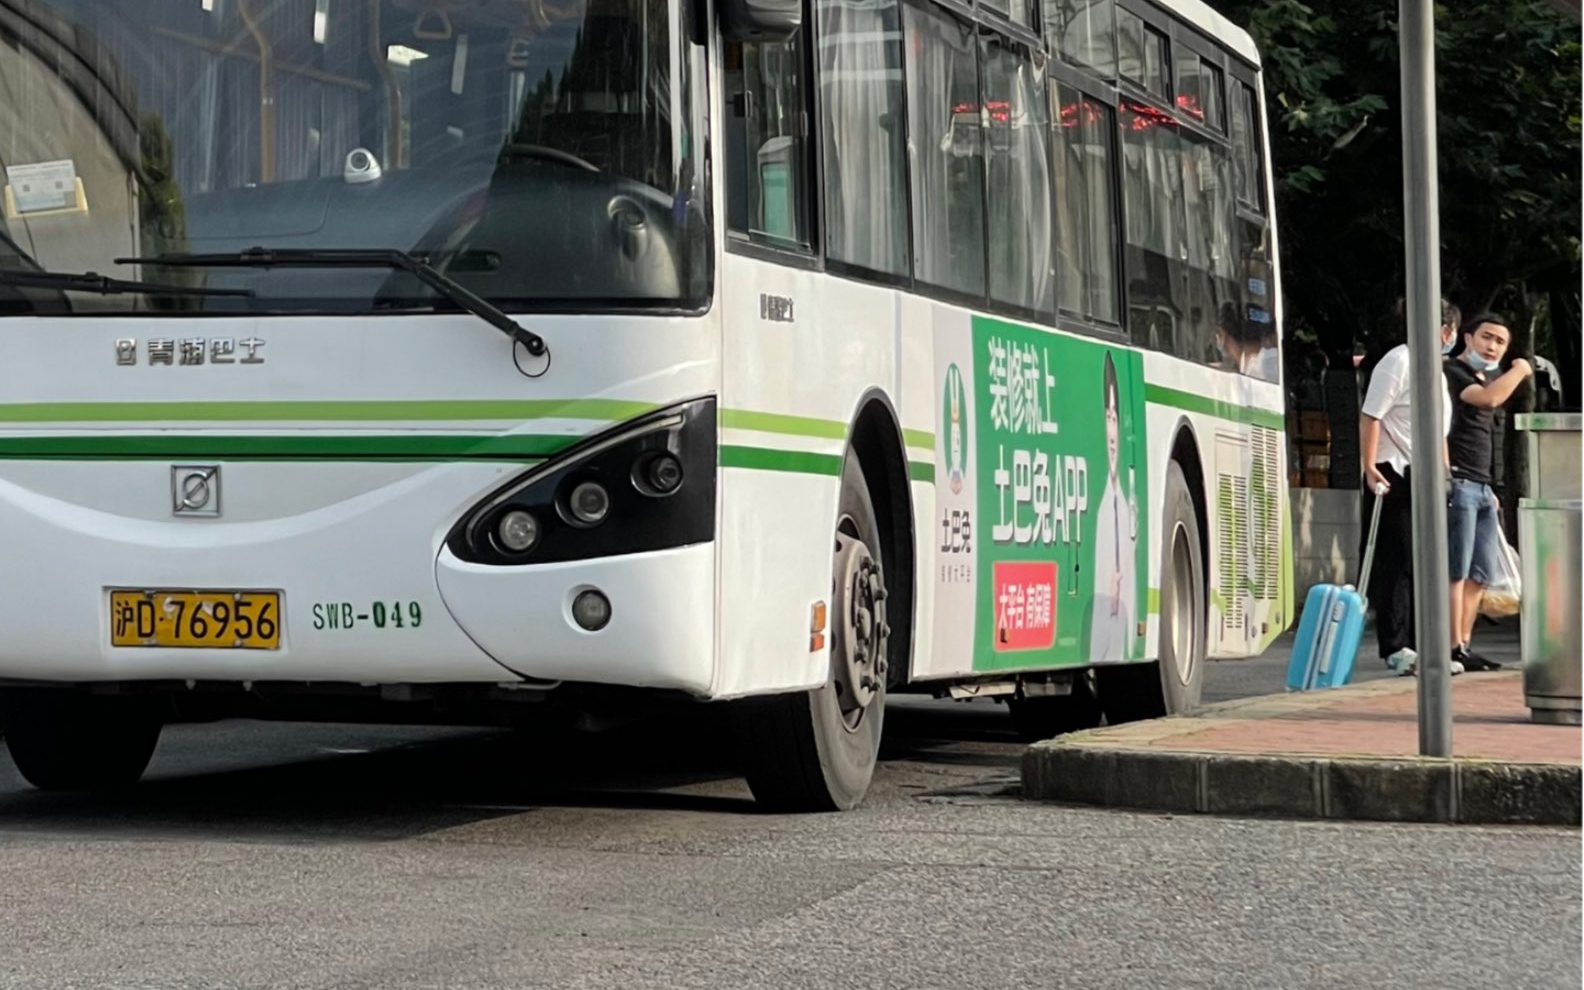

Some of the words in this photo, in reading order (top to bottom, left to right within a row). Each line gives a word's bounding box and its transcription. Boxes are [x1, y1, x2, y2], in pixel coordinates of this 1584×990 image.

[148, 338, 265, 366] 青浦巴士
[988, 336, 1058, 435] 装修就上
[992, 444, 1087, 545] 土巴兔APP
[941, 508, 971, 553] 土巴兔
[312, 601, 423, 630] SWB-049
